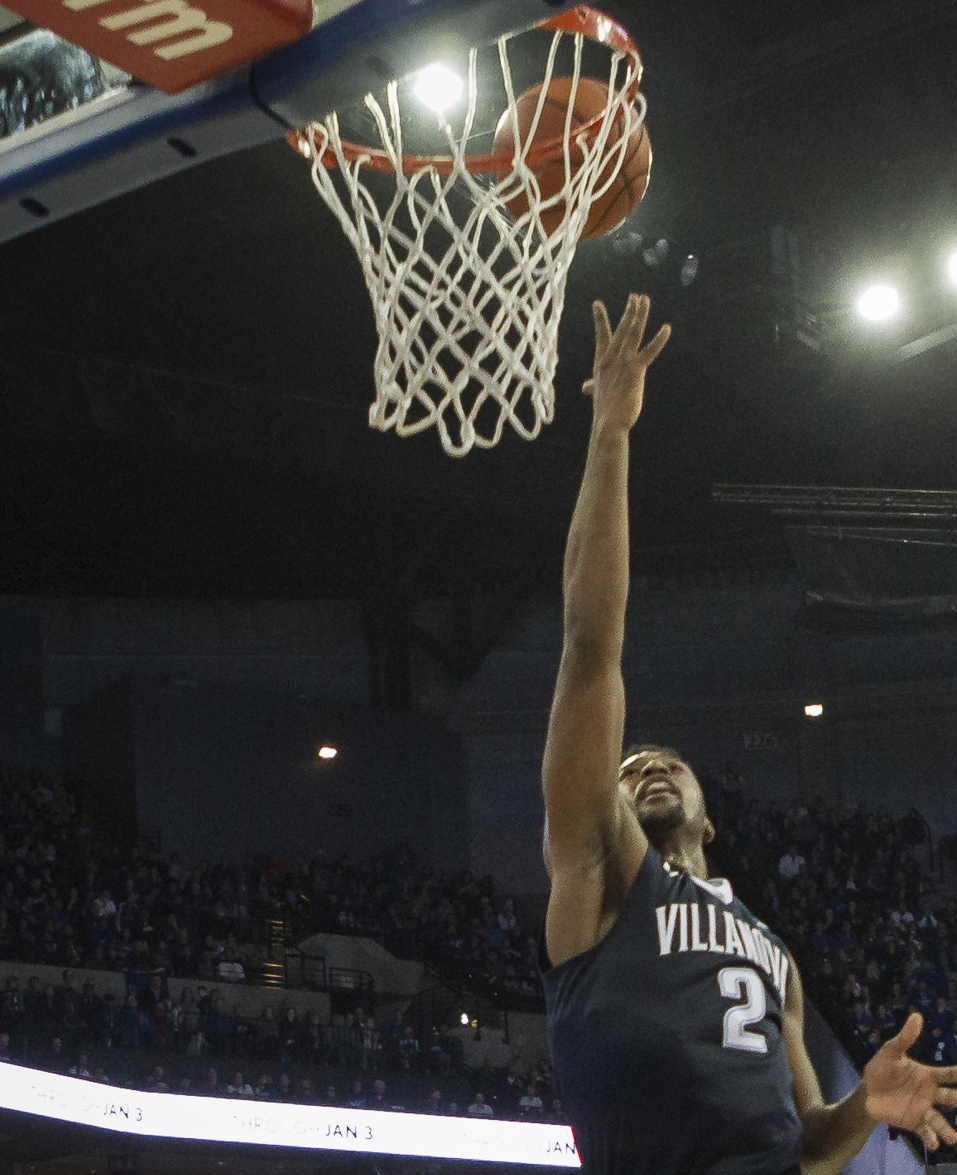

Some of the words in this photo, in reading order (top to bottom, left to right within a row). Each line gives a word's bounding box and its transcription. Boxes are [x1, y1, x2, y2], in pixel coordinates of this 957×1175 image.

[717, 967, 767, 1053] 2
[103, 1102, 130, 1119] JAN
[135, 1108, 143, 1121] 3
[325, 1123, 358, 1138] JAN
[365, 1126, 373, 1140] 3
[546, 1140, 576, 1154] JAN
